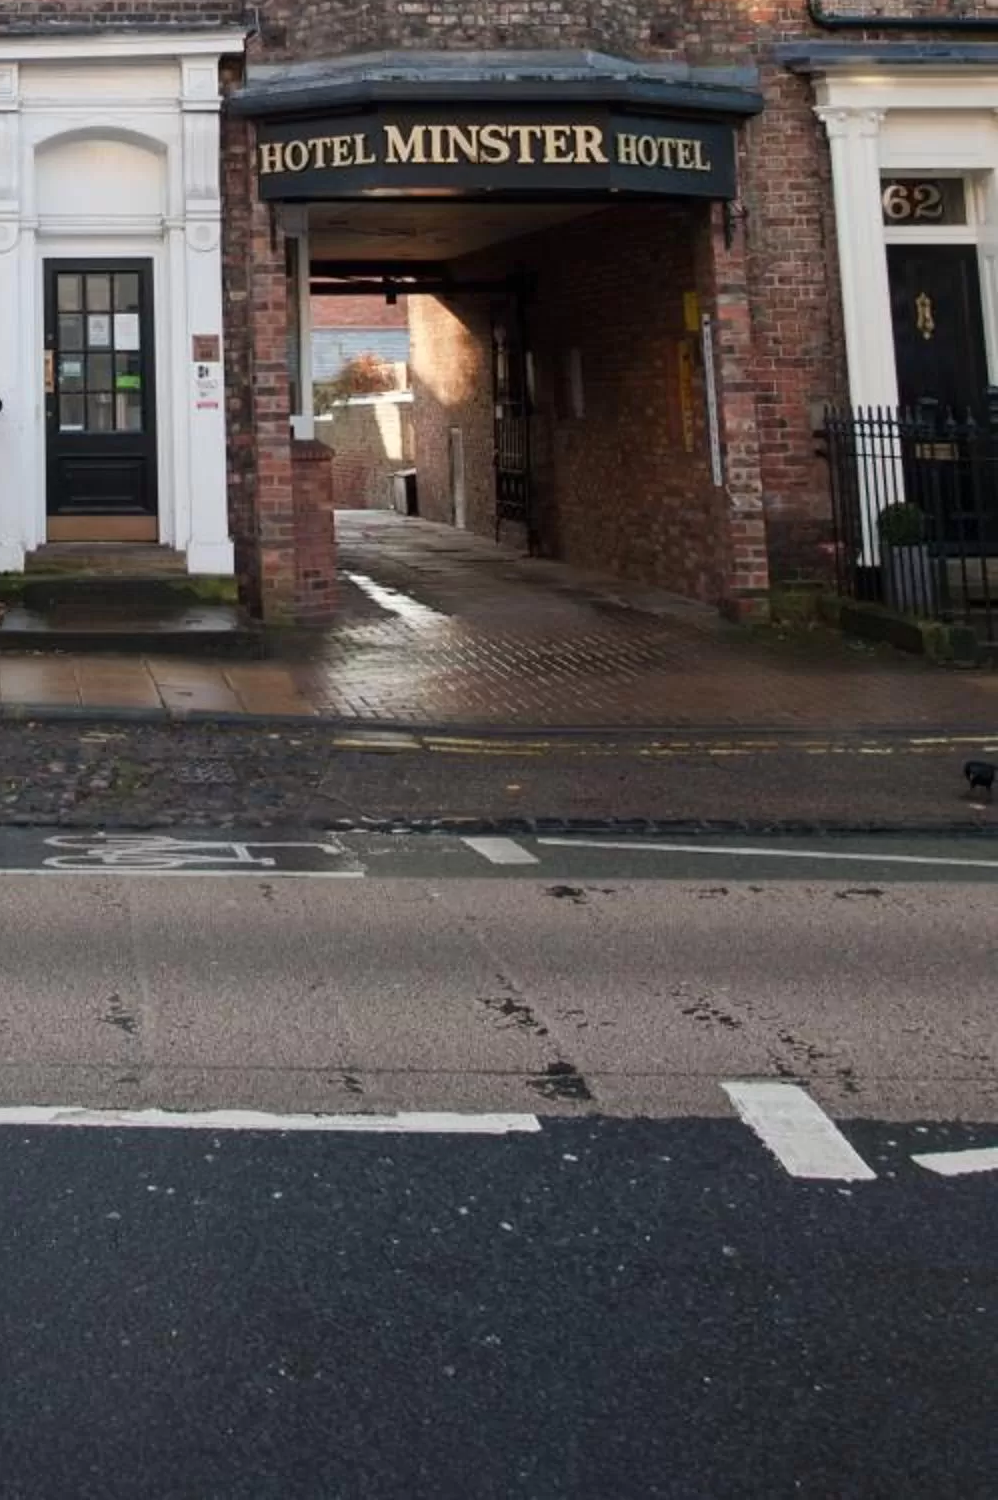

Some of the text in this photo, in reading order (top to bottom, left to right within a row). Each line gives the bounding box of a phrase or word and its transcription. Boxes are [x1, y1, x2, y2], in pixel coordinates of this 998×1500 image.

[259, 124, 711, 174] HOTEL MINSTER HOTEL
[883, 184, 942, 219] 62
